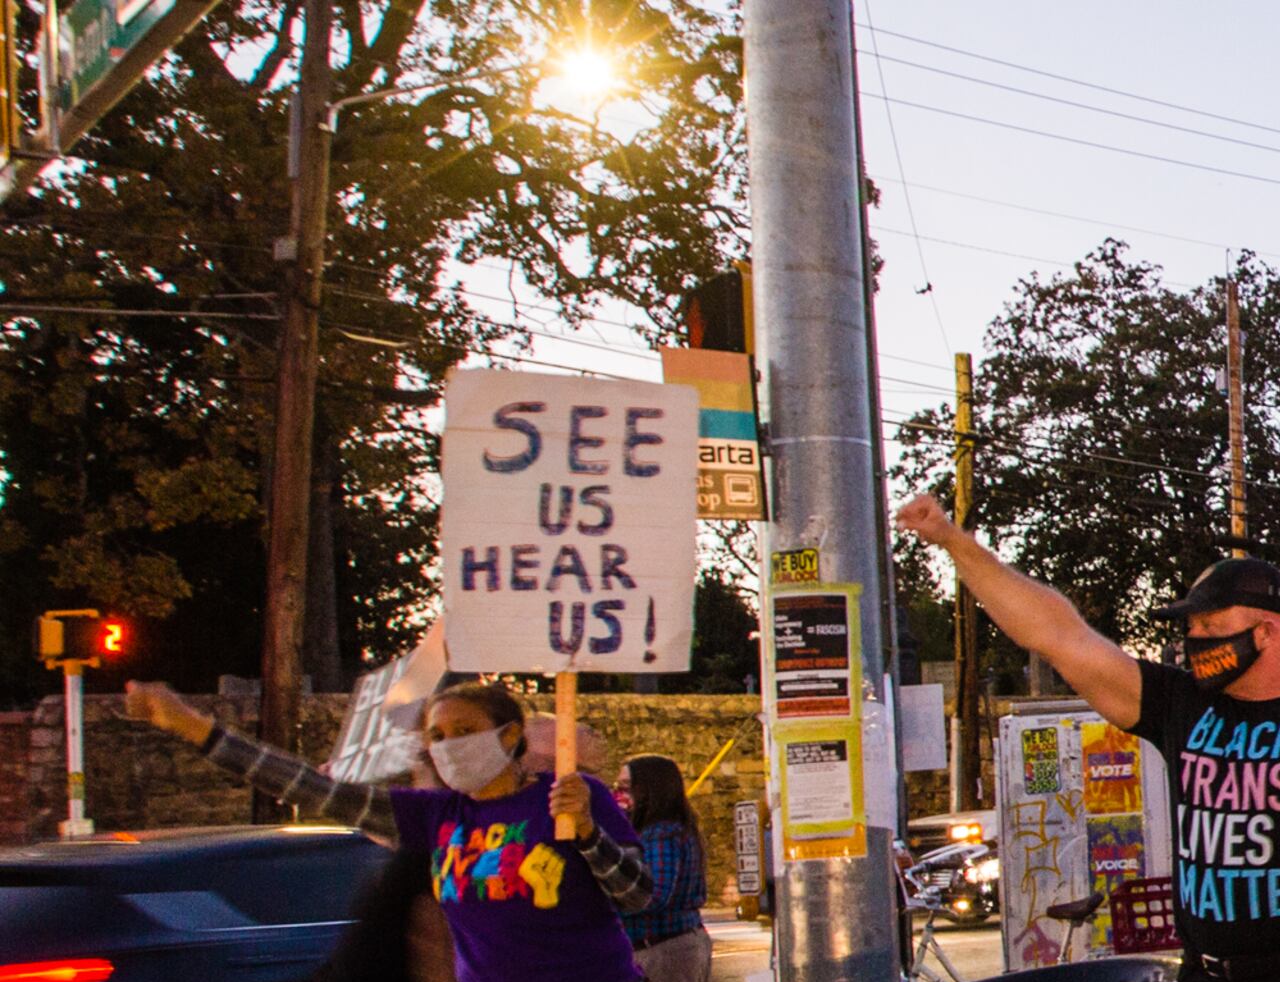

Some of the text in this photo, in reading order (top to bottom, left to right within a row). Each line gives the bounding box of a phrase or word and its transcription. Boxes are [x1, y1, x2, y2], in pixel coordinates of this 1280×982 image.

[482, 401, 664, 477] SEE
[698, 443, 755, 465] arta
[538, 483, 614, 536] US
[460, 544, 637, 593] HEAR
[790, 552, 816, 571] BUY
[105, 624, 122, 652] 2
[548, 595, 657, 664] US!
[1090, 764, 1133, 778] VOTE
[1178, 804, 1275, 867] LIVES
[1094, 857, 1139, 873] VOICE
